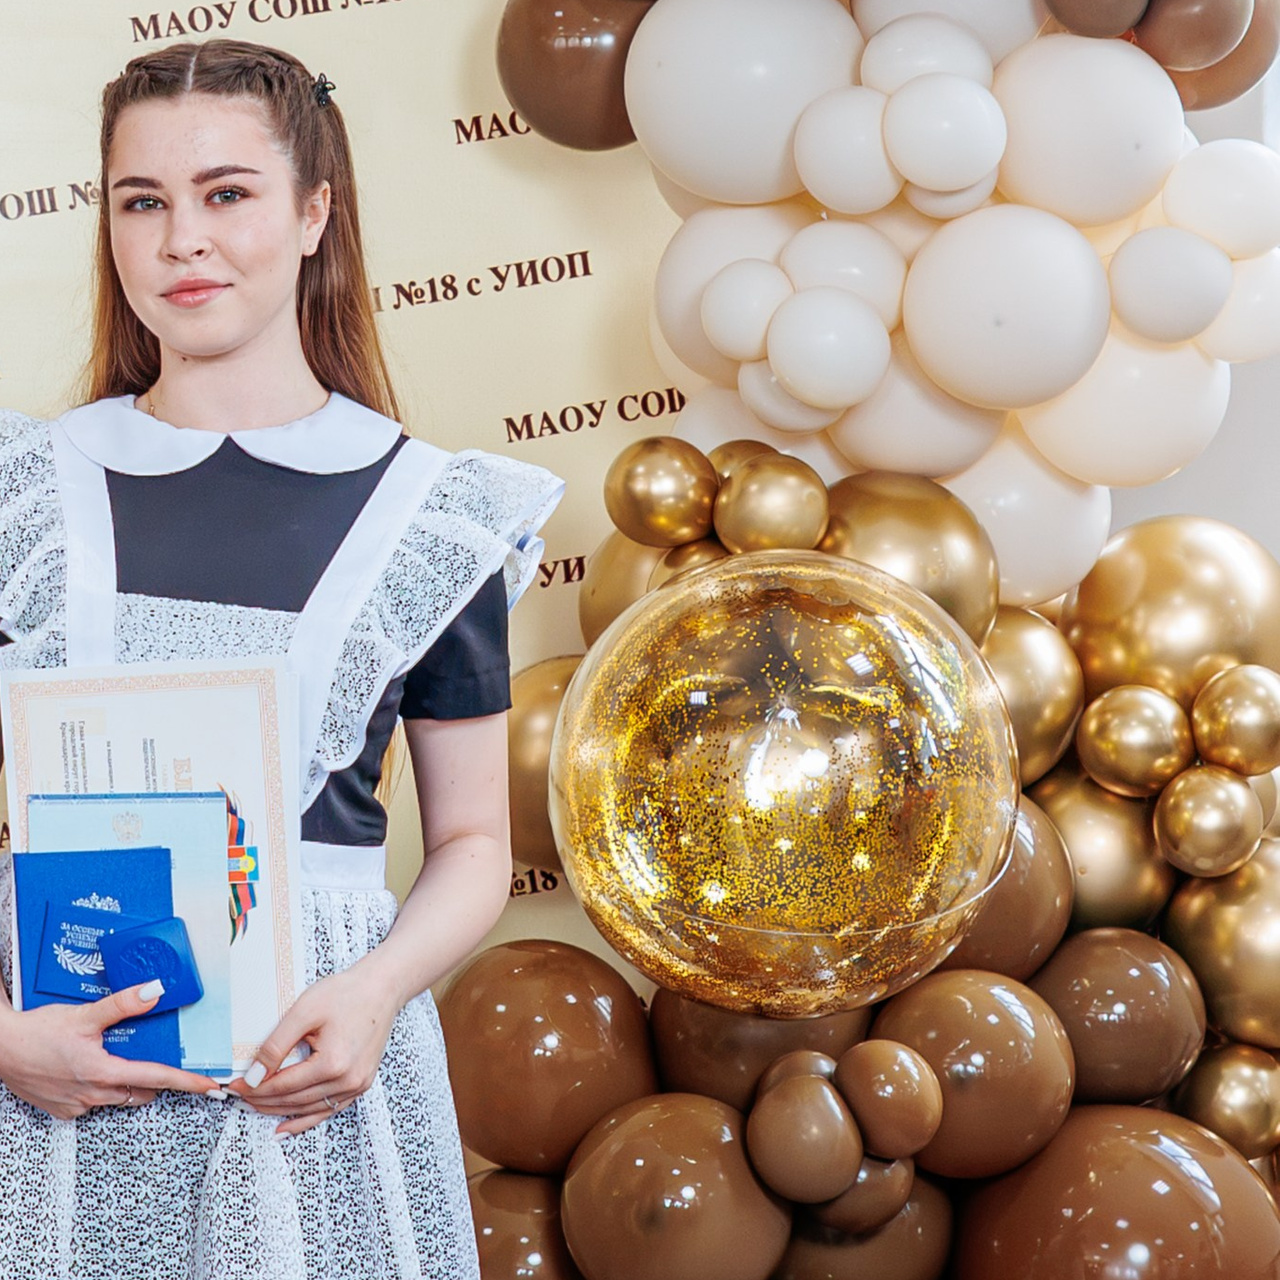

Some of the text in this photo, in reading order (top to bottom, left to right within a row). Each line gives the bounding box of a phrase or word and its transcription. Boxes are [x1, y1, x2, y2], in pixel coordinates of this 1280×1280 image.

[130, 1, 237, 43] МАОУ
[392, 274, 458, 310] №18
[466, 276, 482, 296] с
[488, 250, 592, 292] УИОП
[503, 399, 607, 443] МАОУ
